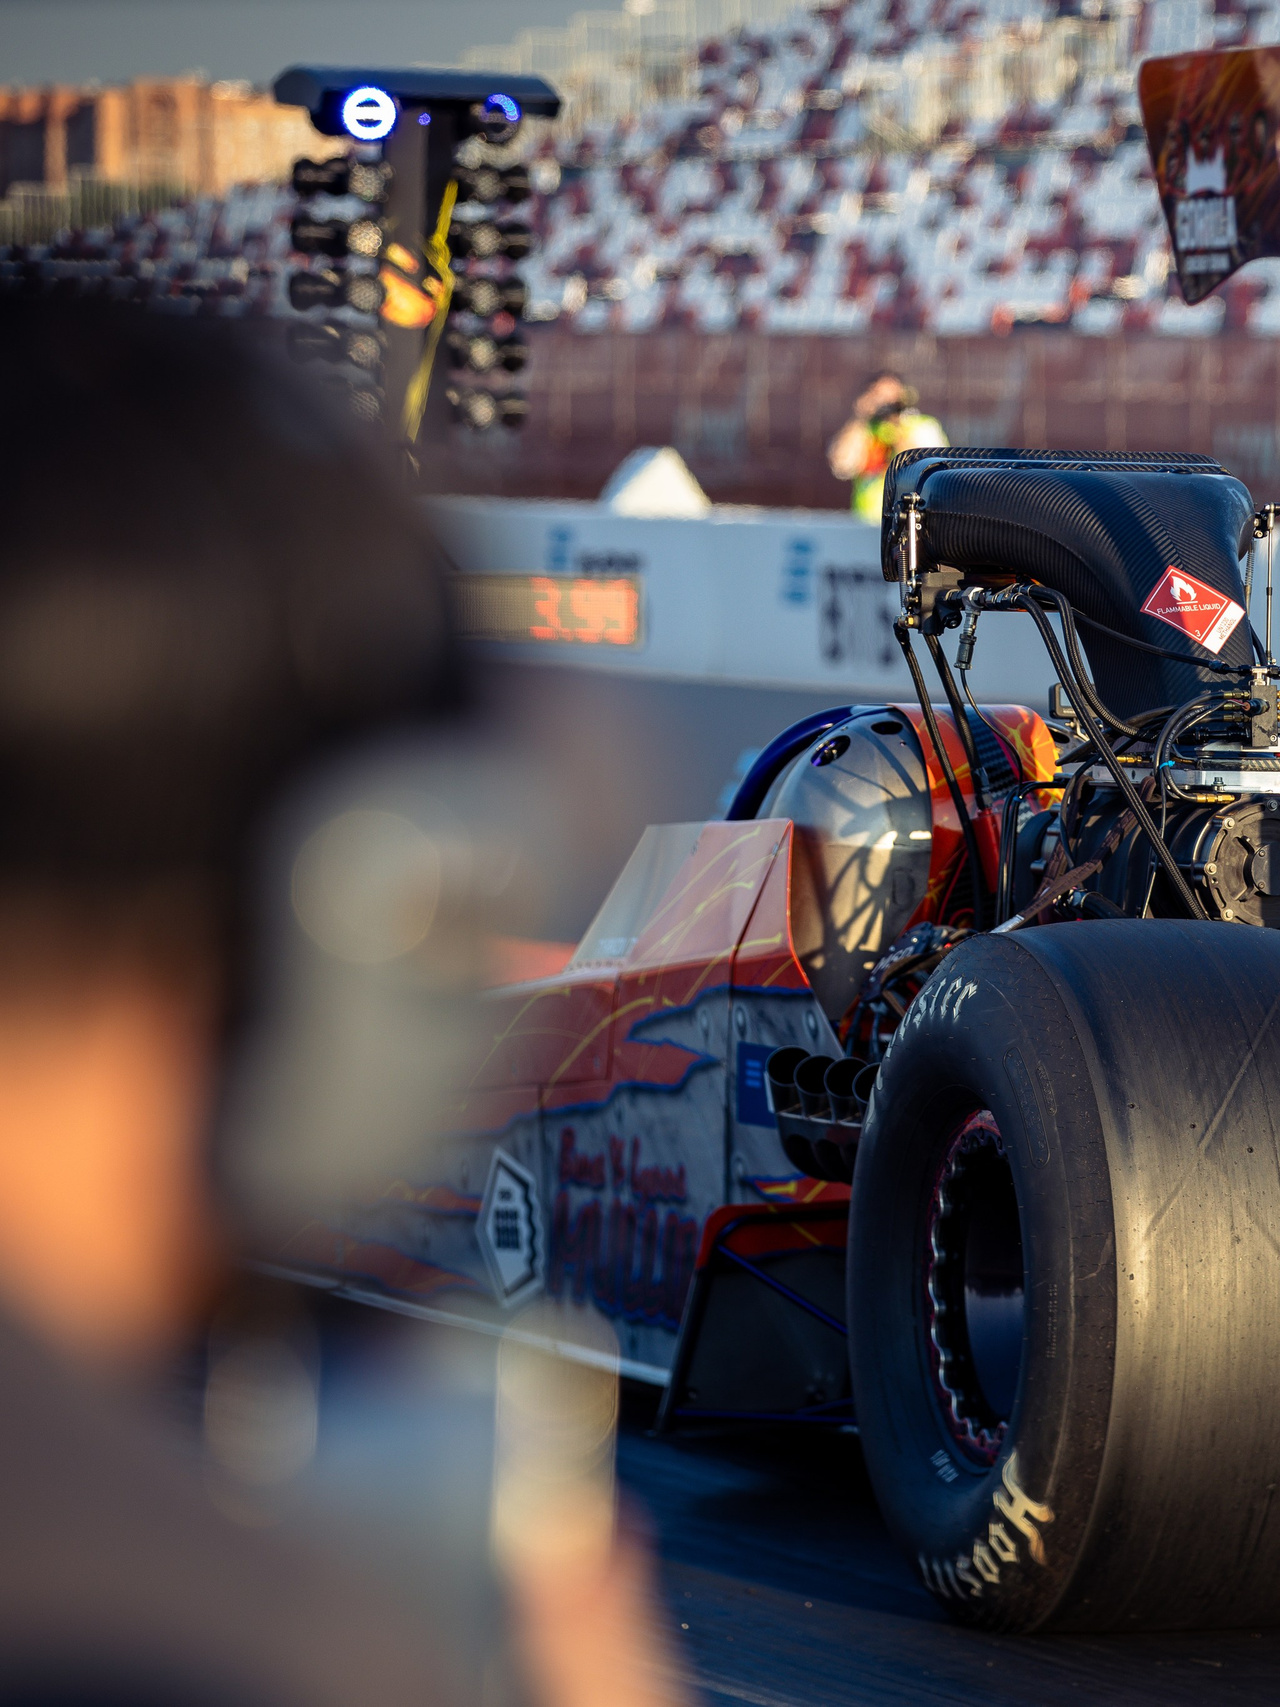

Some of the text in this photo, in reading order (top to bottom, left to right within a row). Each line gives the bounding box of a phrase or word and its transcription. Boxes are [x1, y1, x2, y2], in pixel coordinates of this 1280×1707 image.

[1157, 603, 1220, 614] FLAMMABLE LIQUID
[1194, 629, 1201, 637] 3
